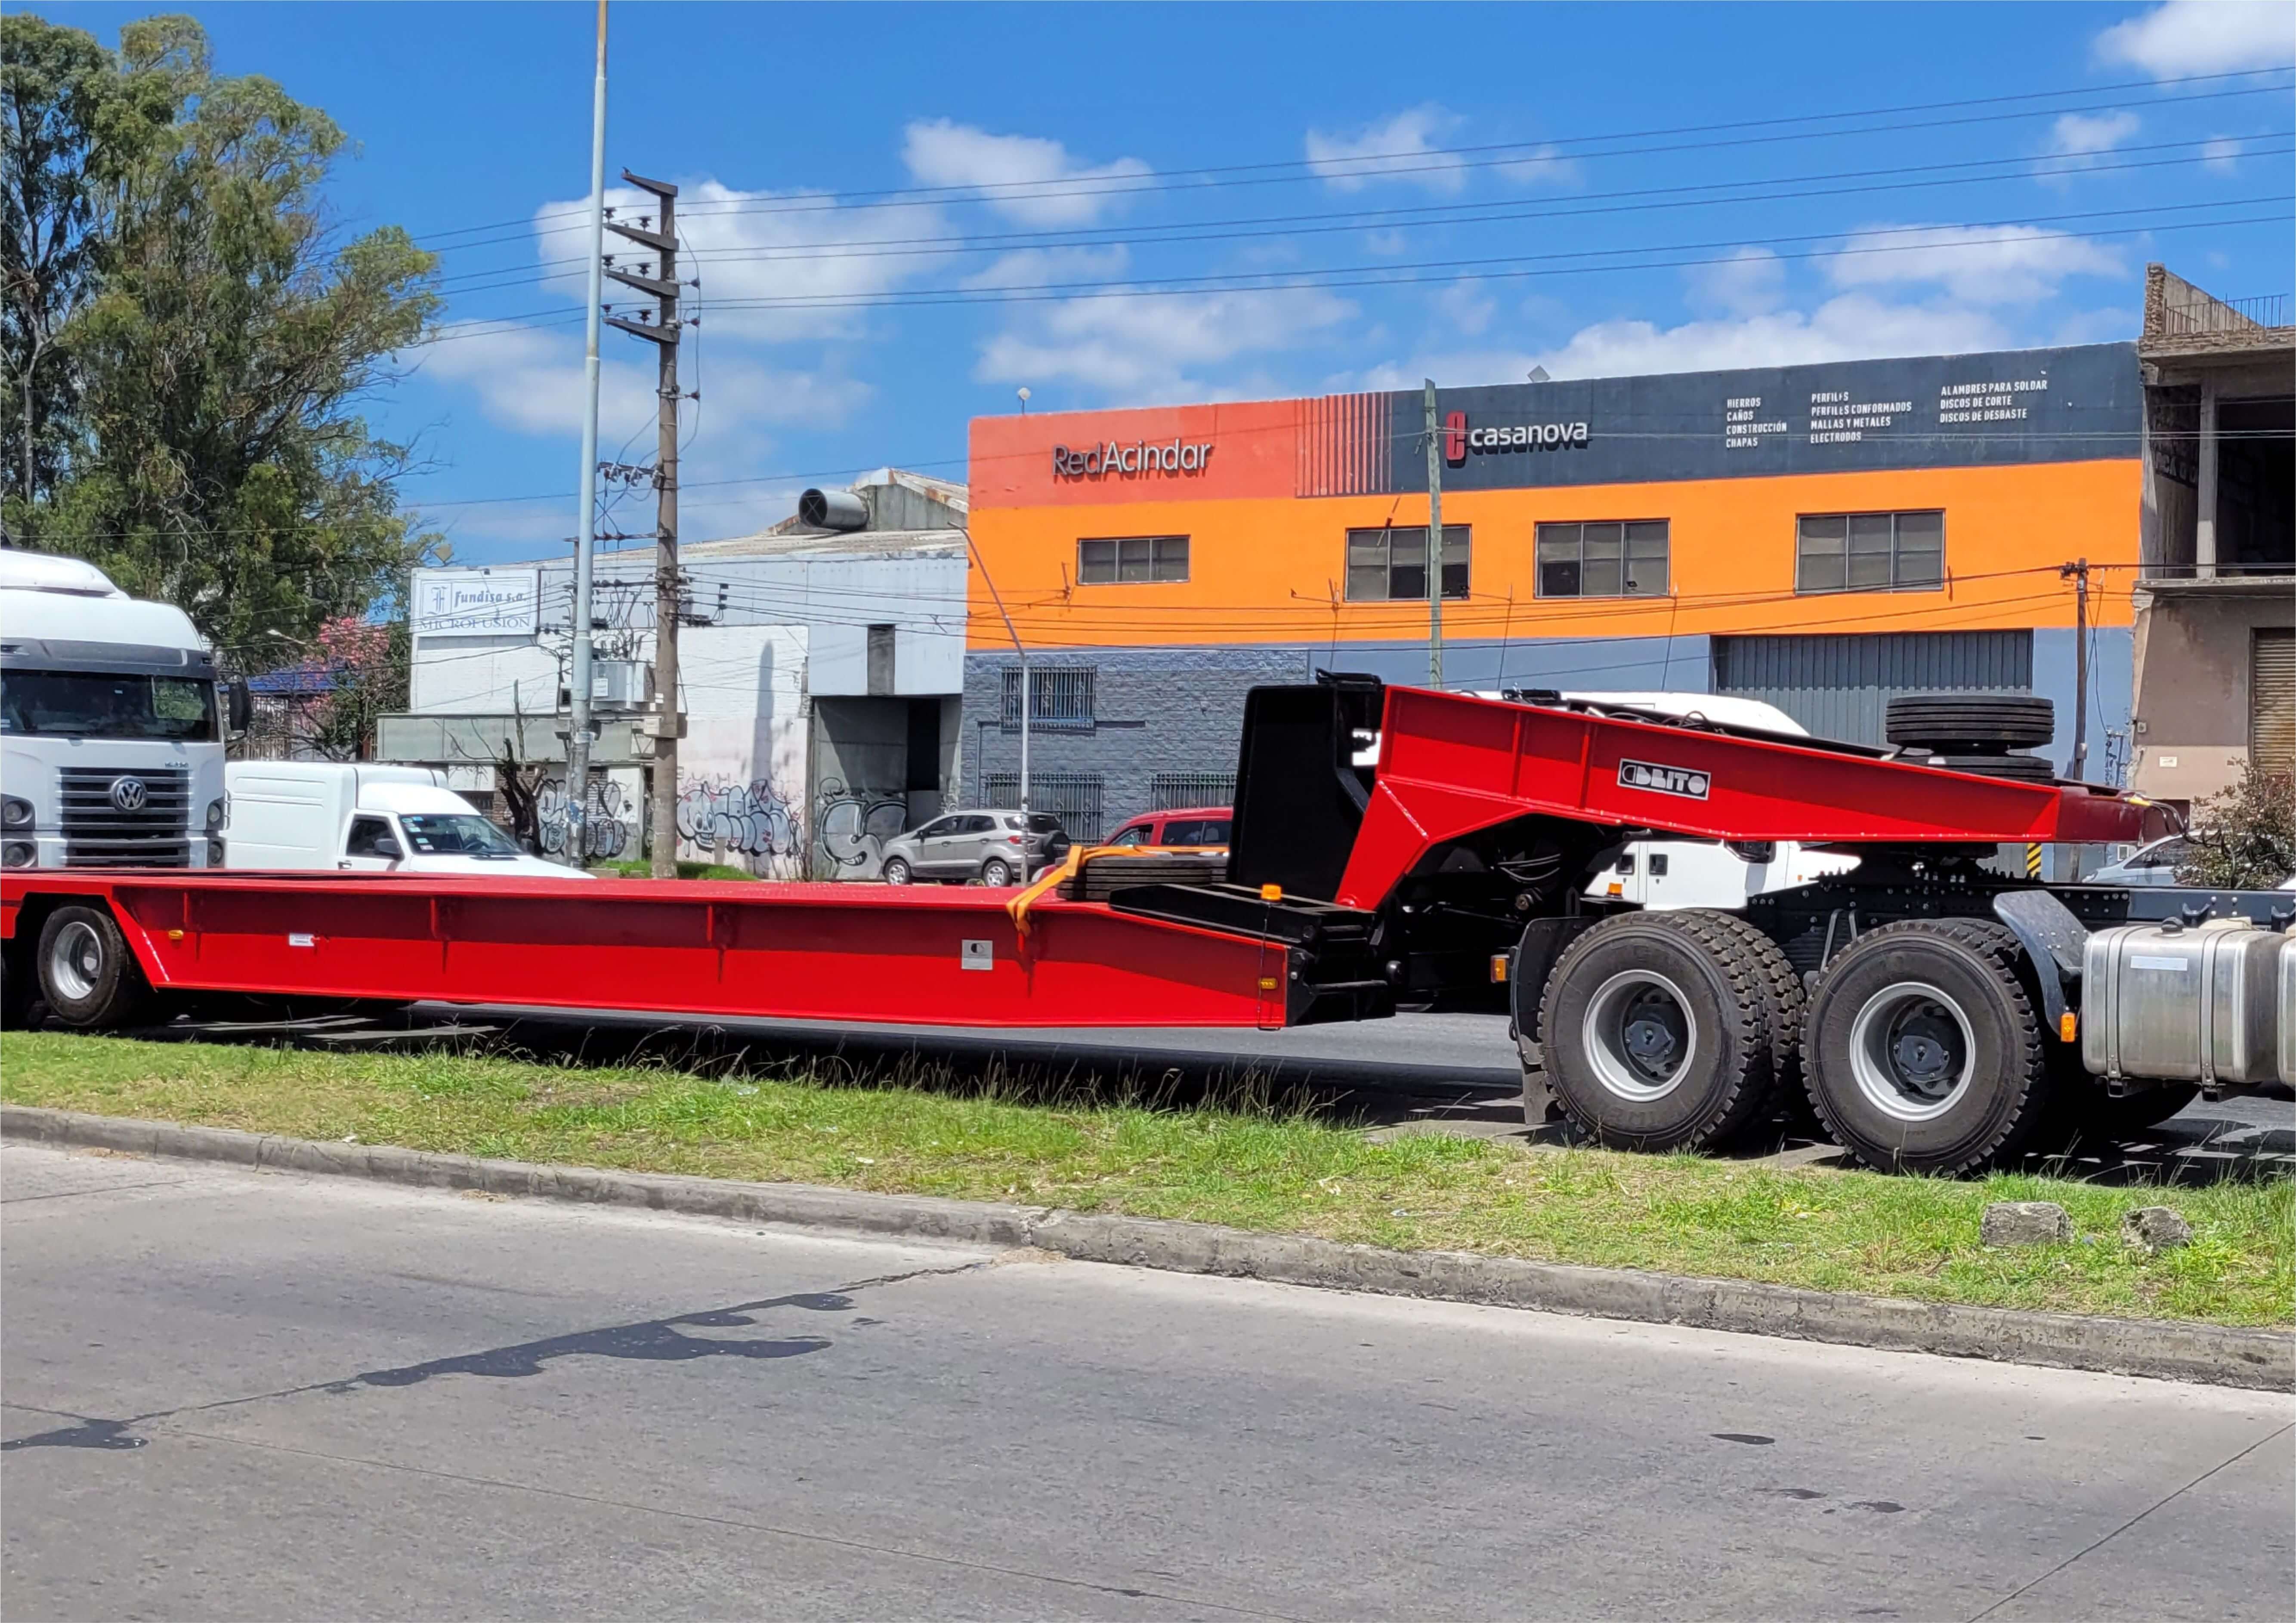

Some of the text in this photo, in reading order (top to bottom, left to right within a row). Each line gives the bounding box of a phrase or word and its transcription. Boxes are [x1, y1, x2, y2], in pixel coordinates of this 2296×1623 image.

[1941, 380, 2048, 396] ALAMBRES PARA SOLDAR
[1727, 397, 1761, 408] HIERROS
[1811, 391, 1849, 403] PERFILES
[1940, 395, 2012, 410] DISCOS DE CORTE
[1727, 410, 1754, 422] CAÑOS
[1811, 401, 1912, 417] PERFILES CONFORMADOS
[1940, 408, 2027, 423] DISCOS DE DESBASTE
[1726, 420, 1787, 435] CONSTRUCCIÓN
[1811, 416, 1891, 430] MALLAS Y METALES
[1471, 422, 1588, 447] casanova
[1810, 432, 1862, 444] ELECTRODOS
[1726, 437, 1758, 448] CHAPAS
[1052, 438, 1211, 476] RedAcindar
